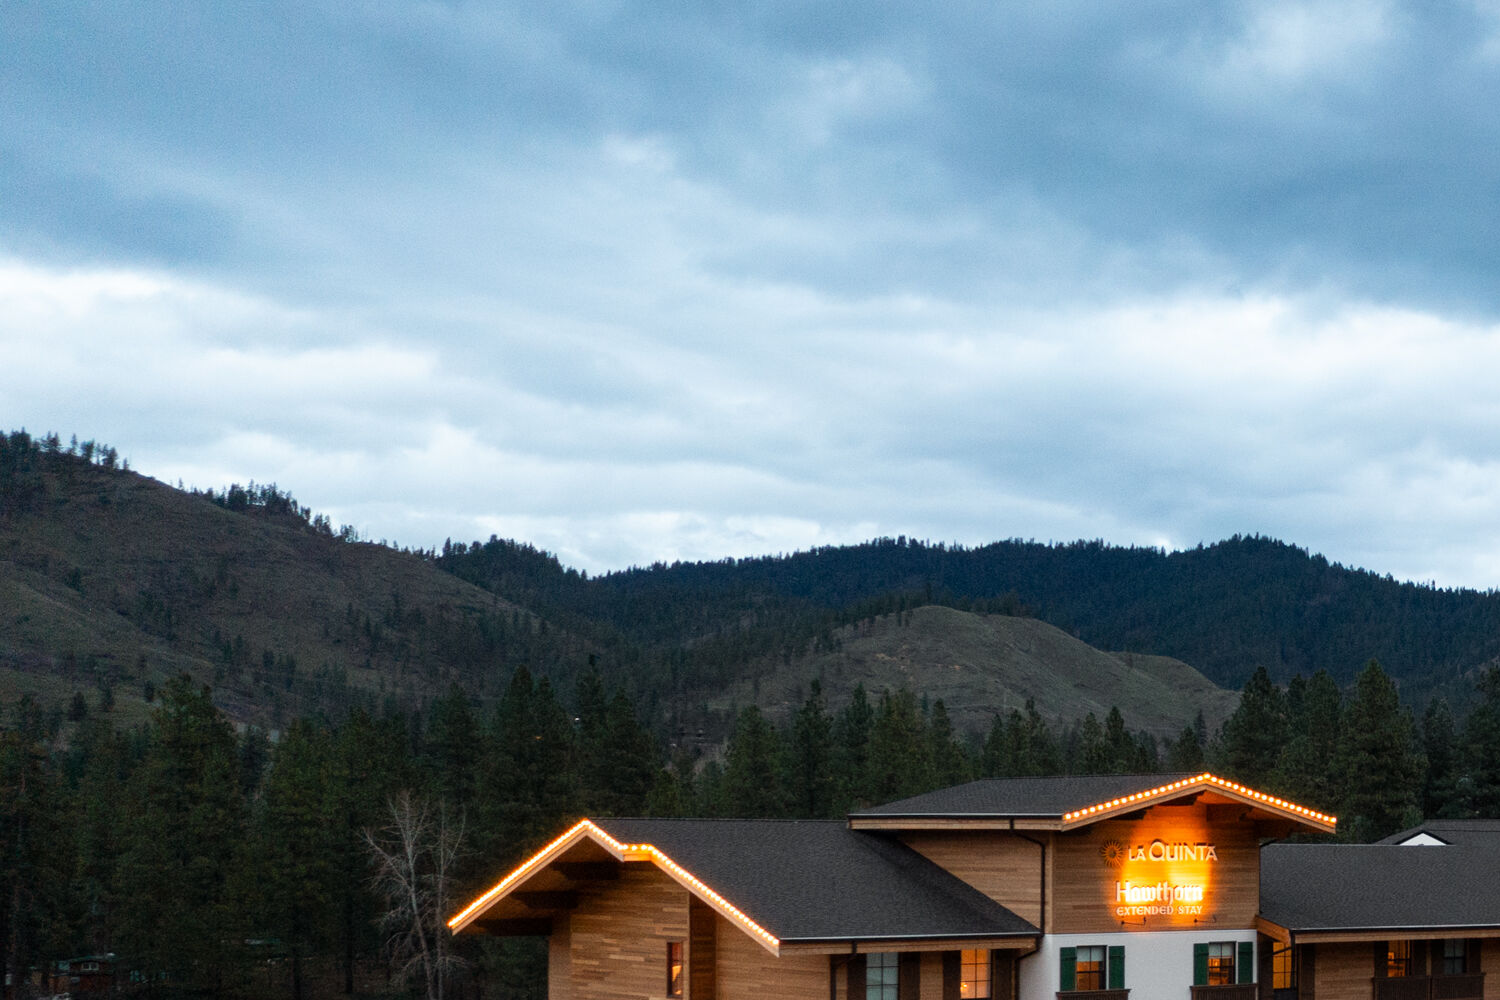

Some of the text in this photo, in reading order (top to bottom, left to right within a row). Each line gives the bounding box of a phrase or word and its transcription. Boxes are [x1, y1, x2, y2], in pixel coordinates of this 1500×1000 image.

[1128, 841, 1218, 861] LA QUINTA
[1116, 881, 1203, 904] Hawthorn
[1116, 906, 1203, 916] EXTENDED STAY
